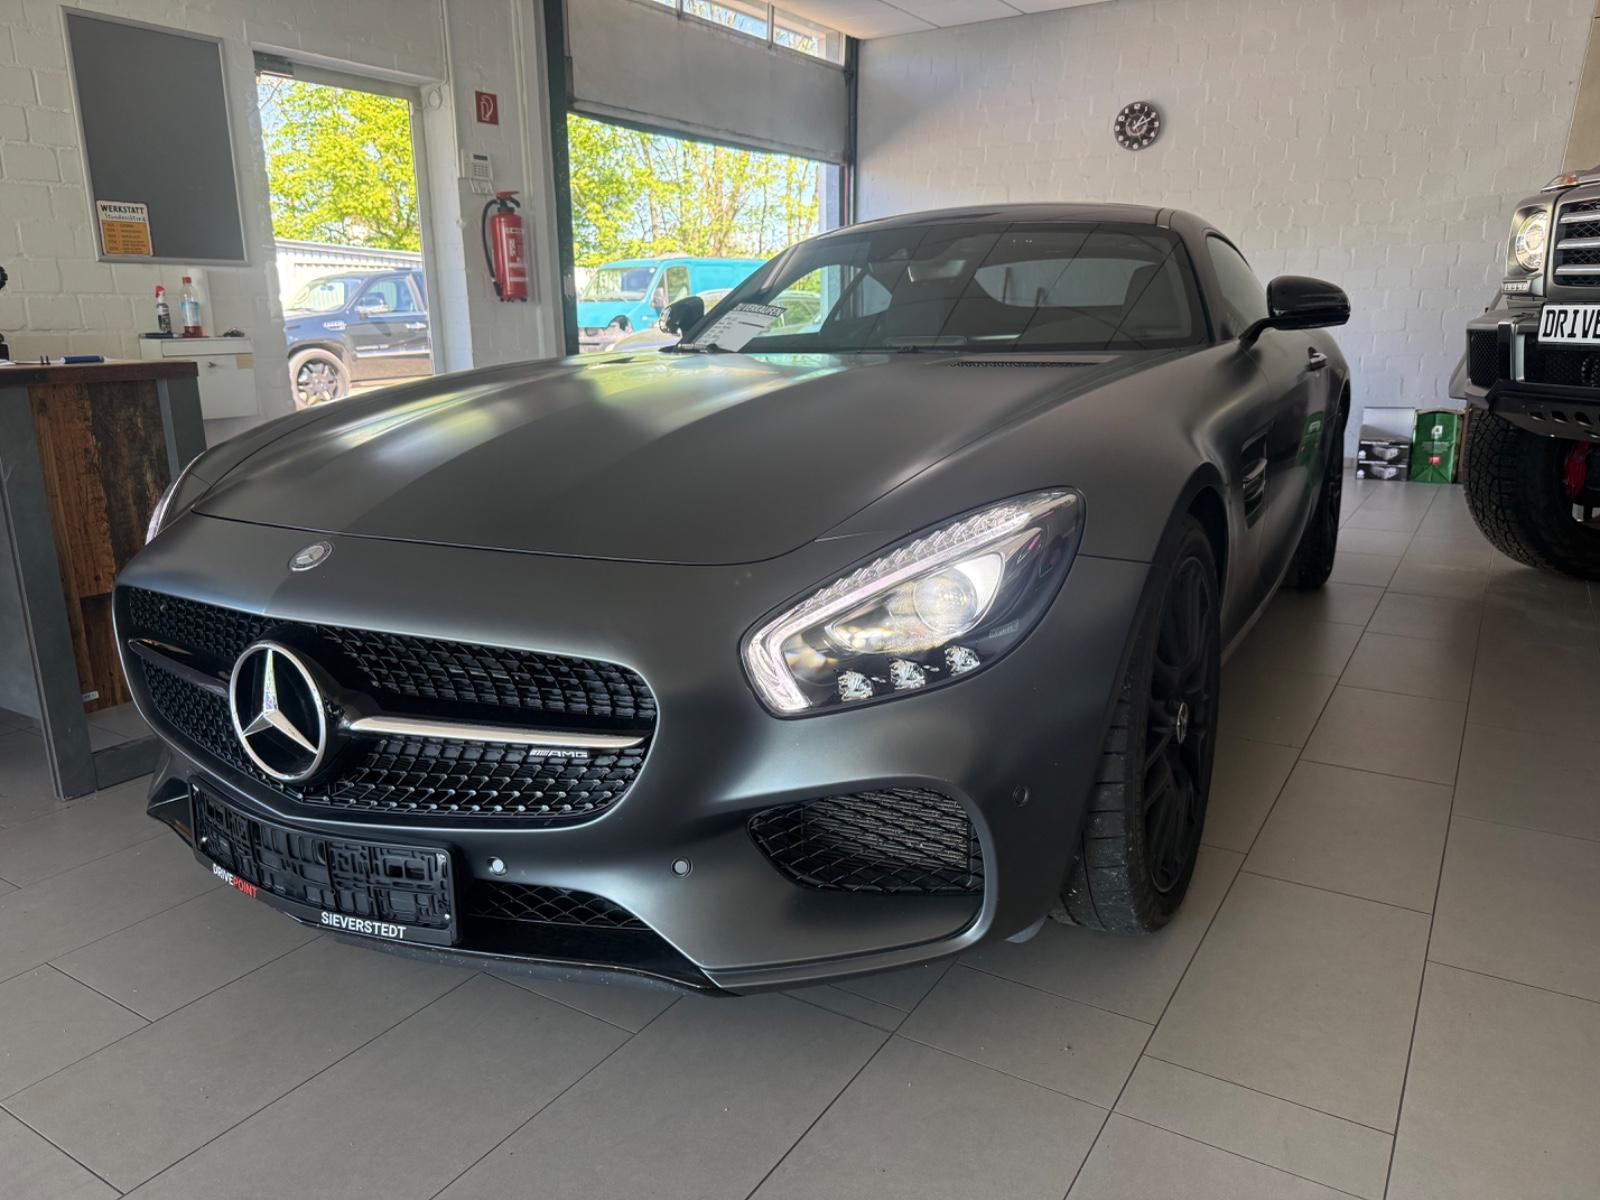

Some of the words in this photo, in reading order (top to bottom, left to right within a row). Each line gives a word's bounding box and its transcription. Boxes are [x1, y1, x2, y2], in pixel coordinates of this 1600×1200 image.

[101, 205, 143, 214] WERKSTATT
[1543, 310, 1600, 338] DRIVE
[548, 749, 588, 758] AMG
[212, 862, 257, 899] DRIVEPOINT
[321, 911, 407, 939] SIEVERSTEDT
